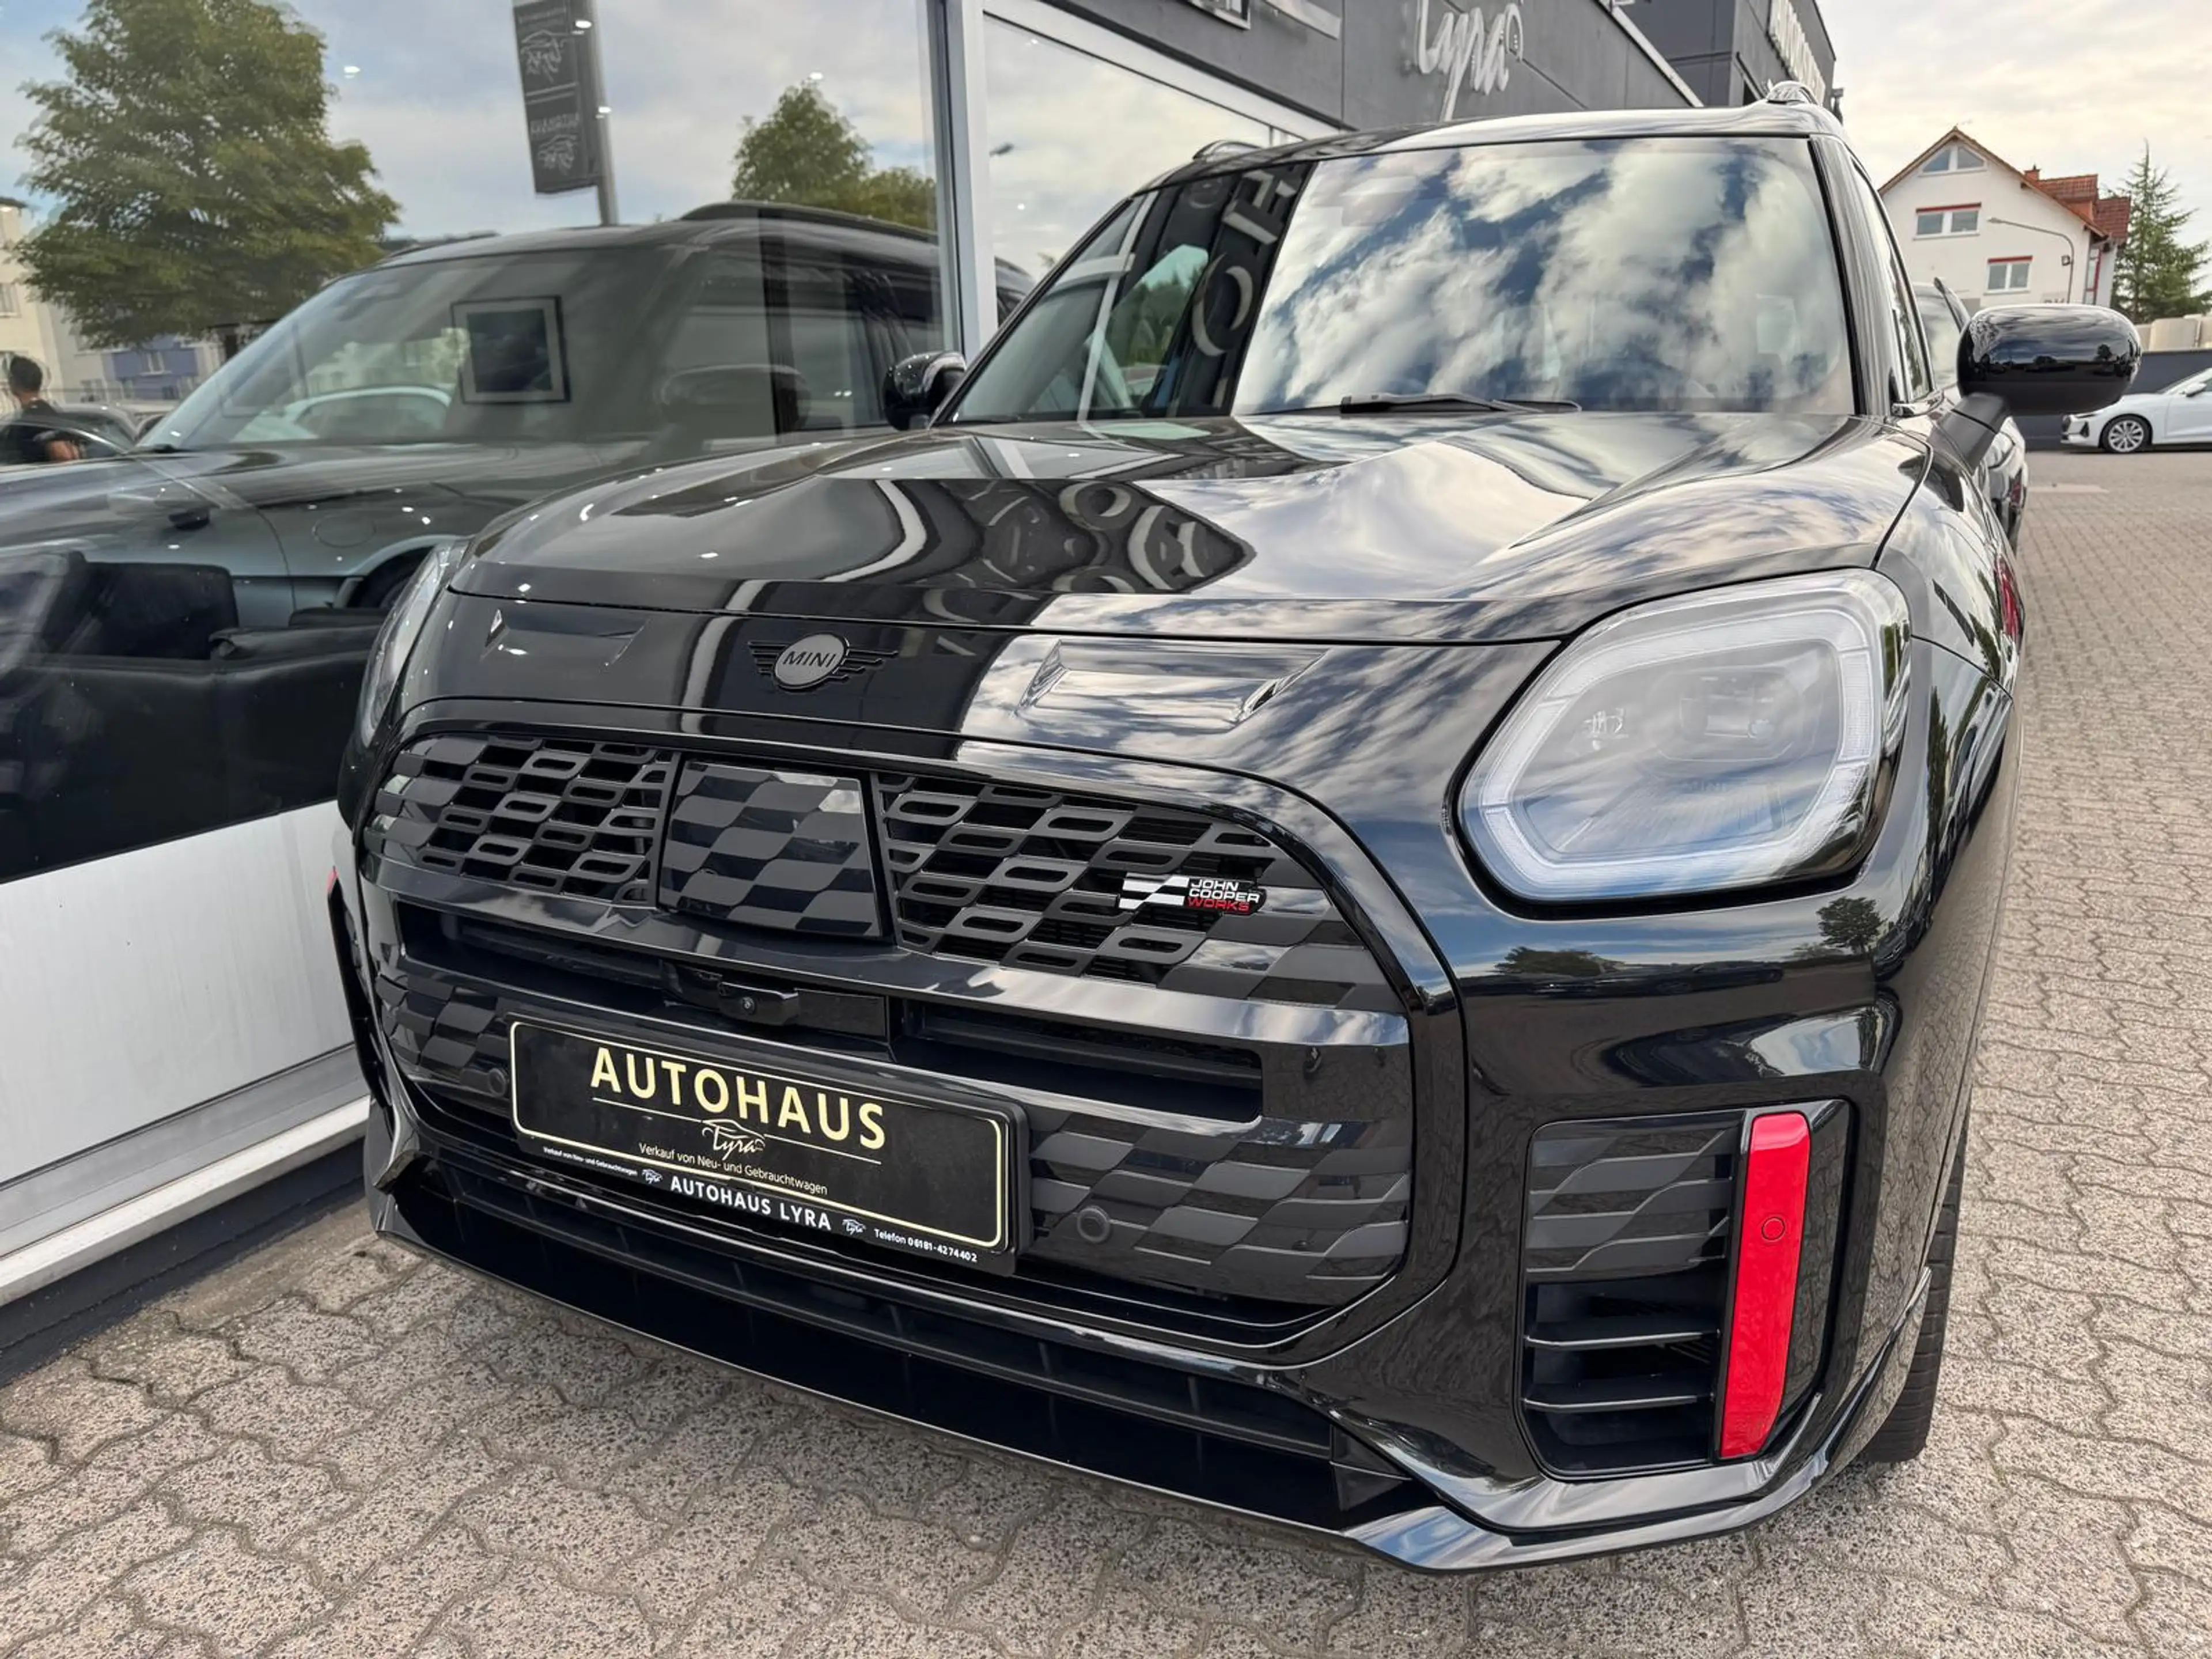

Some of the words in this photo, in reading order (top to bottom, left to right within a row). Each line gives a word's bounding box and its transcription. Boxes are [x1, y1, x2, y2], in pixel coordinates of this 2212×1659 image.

[783, 650, 836, 668] MINI
[1188, 889, 1260, 903] COOPER
[1191, 879, 1239, 891] JOHN
[1187, 897, 1251, 911] WORKS
[590, 1047, 886, 1150] AUTOHAUS
[702, 1126, 766, 1161] Lyra
[639, 1142, 675, 1160] Verkauf
[677, 1153, 695, 1165] von
[697, 1156, 721, 1169] Neu-
[724, 1163, 743, 1173] und
[745, 1165, 828, 1195] Gebrauchtwagen
[670, 1176, 771, 1215] AUTOHAUS
[780, 1202, 831, 1230] LYRA
[874, 1229, 907, 1245] Telefon
